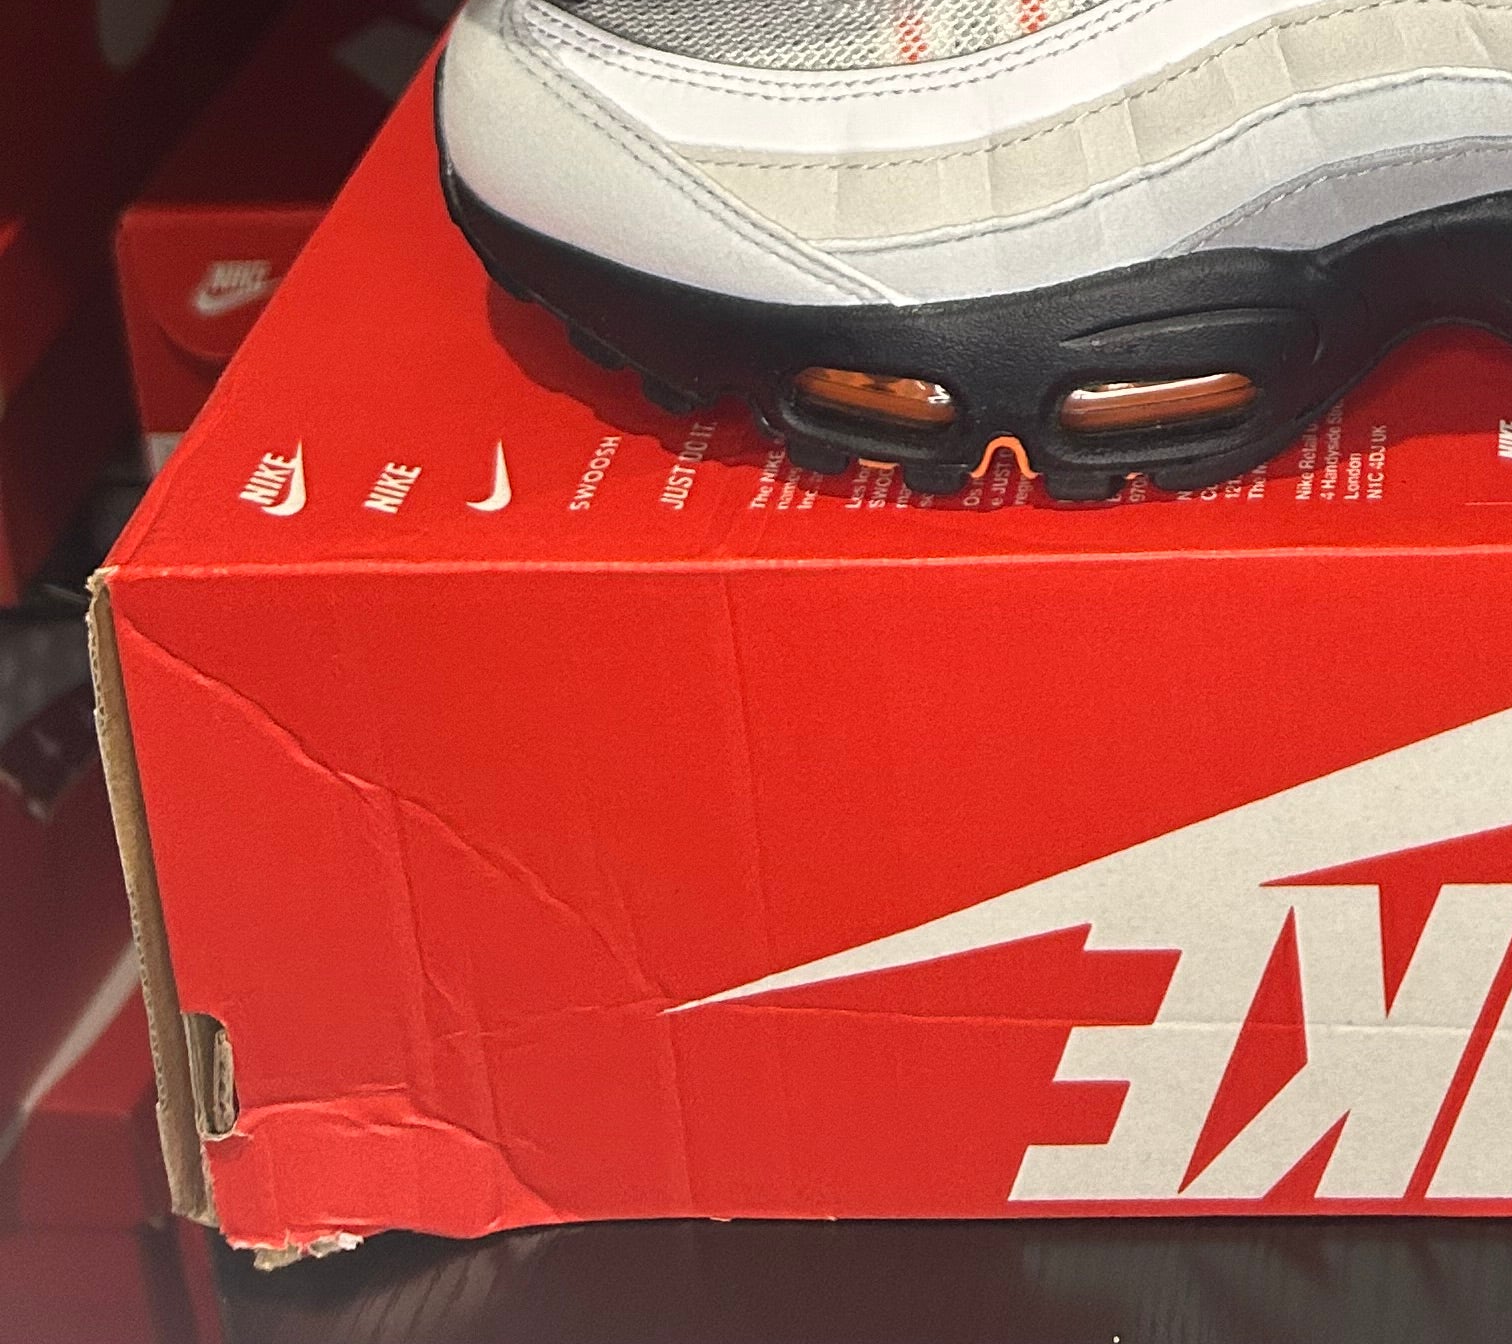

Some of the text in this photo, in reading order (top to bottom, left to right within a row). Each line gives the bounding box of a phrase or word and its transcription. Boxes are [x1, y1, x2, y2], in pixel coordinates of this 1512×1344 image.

[1370, 424, 1388, 442] UK
[238, 451, 298, 507] NIKE
[362, 461, 422, 514] NIKE
[568, 435, 623, 512] SWOOSH
[659, 463, 697, 511] JUST
[678, 439, 709, 463] DO
[749, 448, 786, 509] The NIKE
[1295, 471, 1315, 501] Nike
[1343, 452, 1362, 501] London
